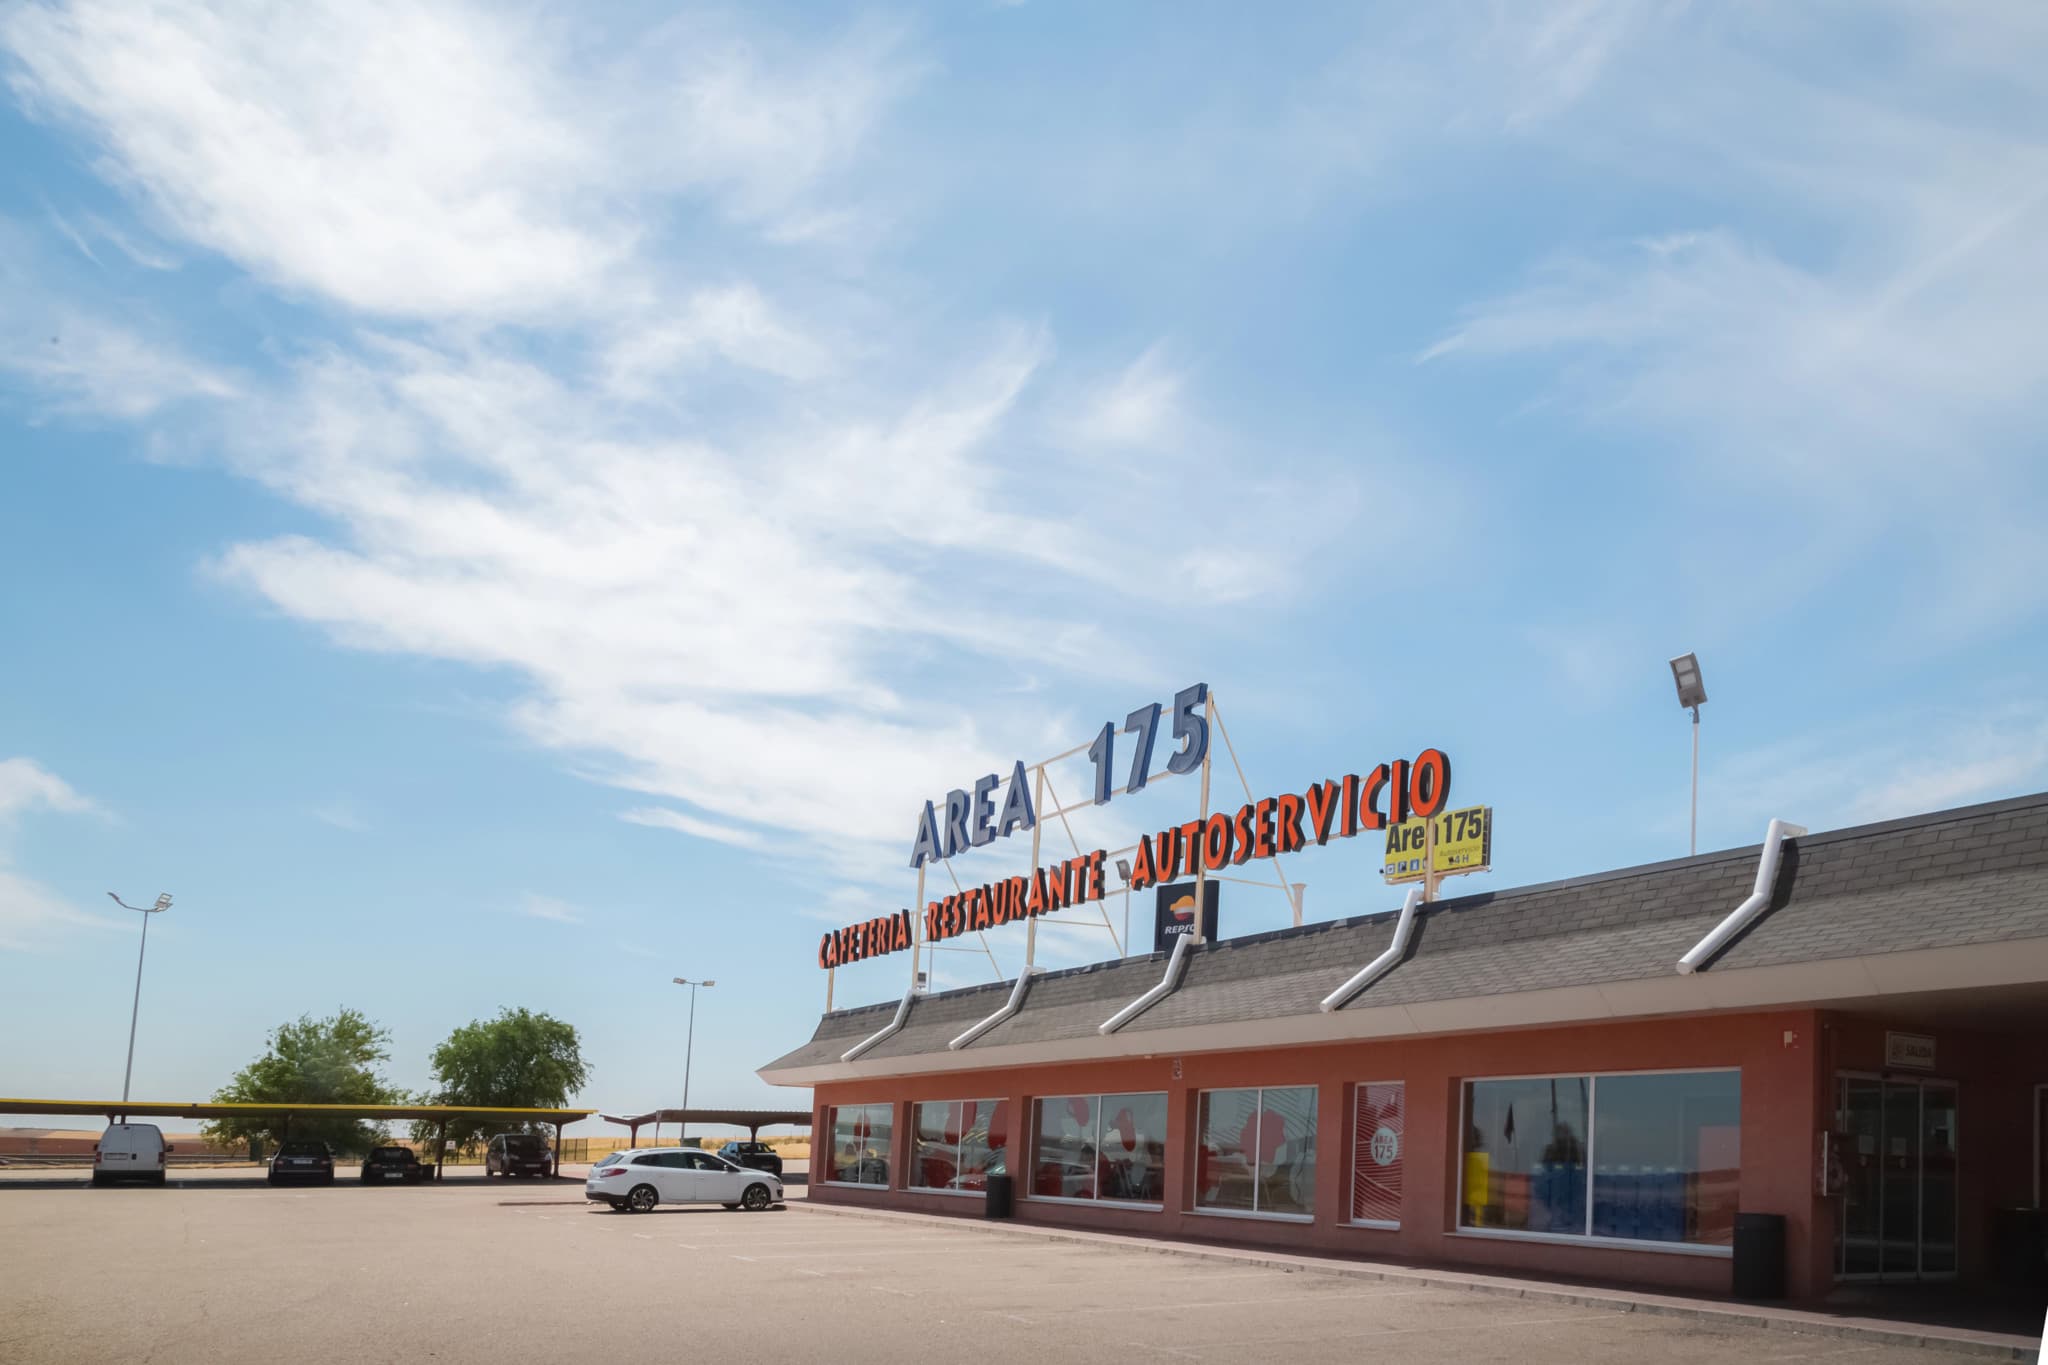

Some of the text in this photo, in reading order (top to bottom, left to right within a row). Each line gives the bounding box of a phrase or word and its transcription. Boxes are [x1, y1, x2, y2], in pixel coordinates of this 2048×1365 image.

[909, 683, 1208, 868] AREA 175
[1443, 808, 1482, 844] 175
[818, 748, 1451, 969] CAFETERIA RESTAURANTE AUTOSERVICIO
[1164, 924, 1196, 935] REPSO
[1375, 1145, 1393, 1160] 175
